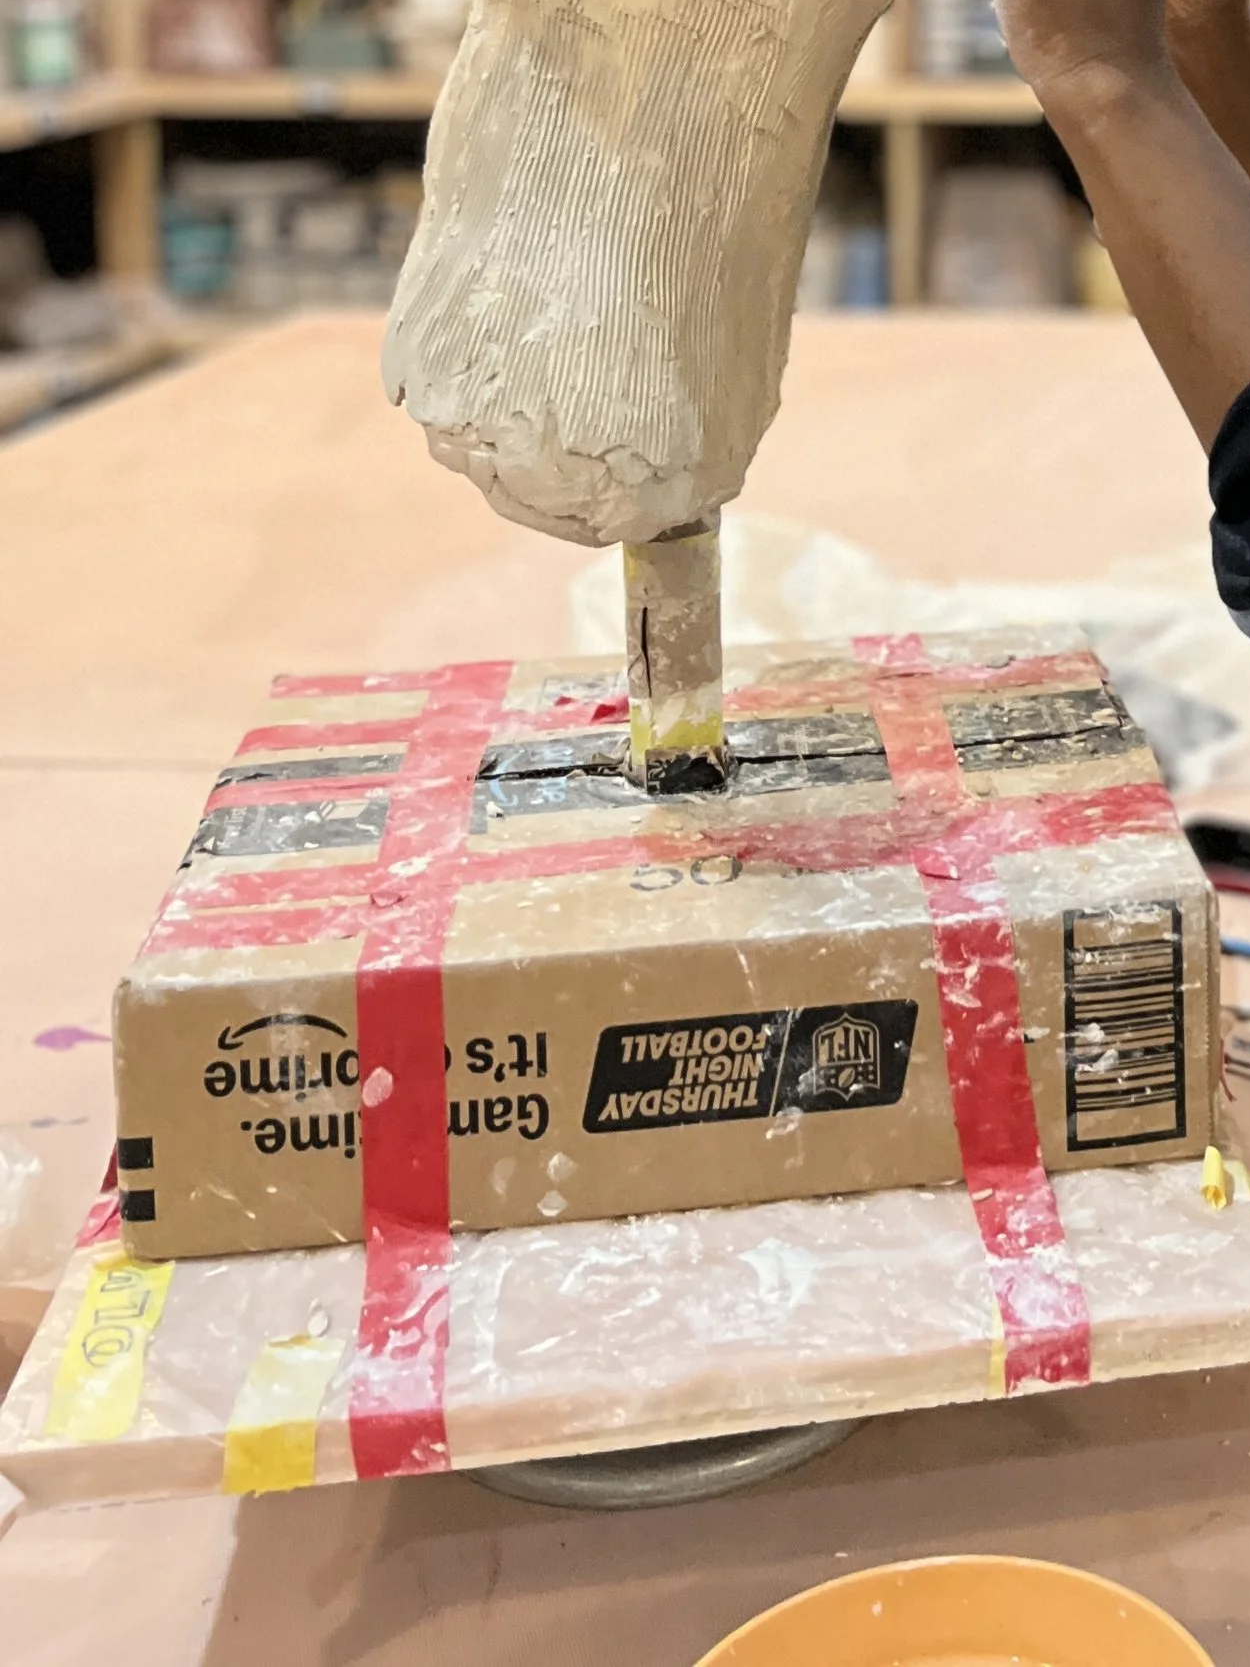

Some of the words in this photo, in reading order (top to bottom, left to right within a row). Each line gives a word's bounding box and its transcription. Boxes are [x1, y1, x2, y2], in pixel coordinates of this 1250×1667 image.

[465, 1031, 548, 1083] It's
[620, 1022, 767, 1064] FOOTBALL
[817, 1026, 874, 1068] NFL
[667, 1052, 765, 1086] NIGHT
[446, 1092, 550, 1141] Gam
[597, 1079, 759, 1122] THURSDAY
[240, 1111, 363, 1160] ime.
